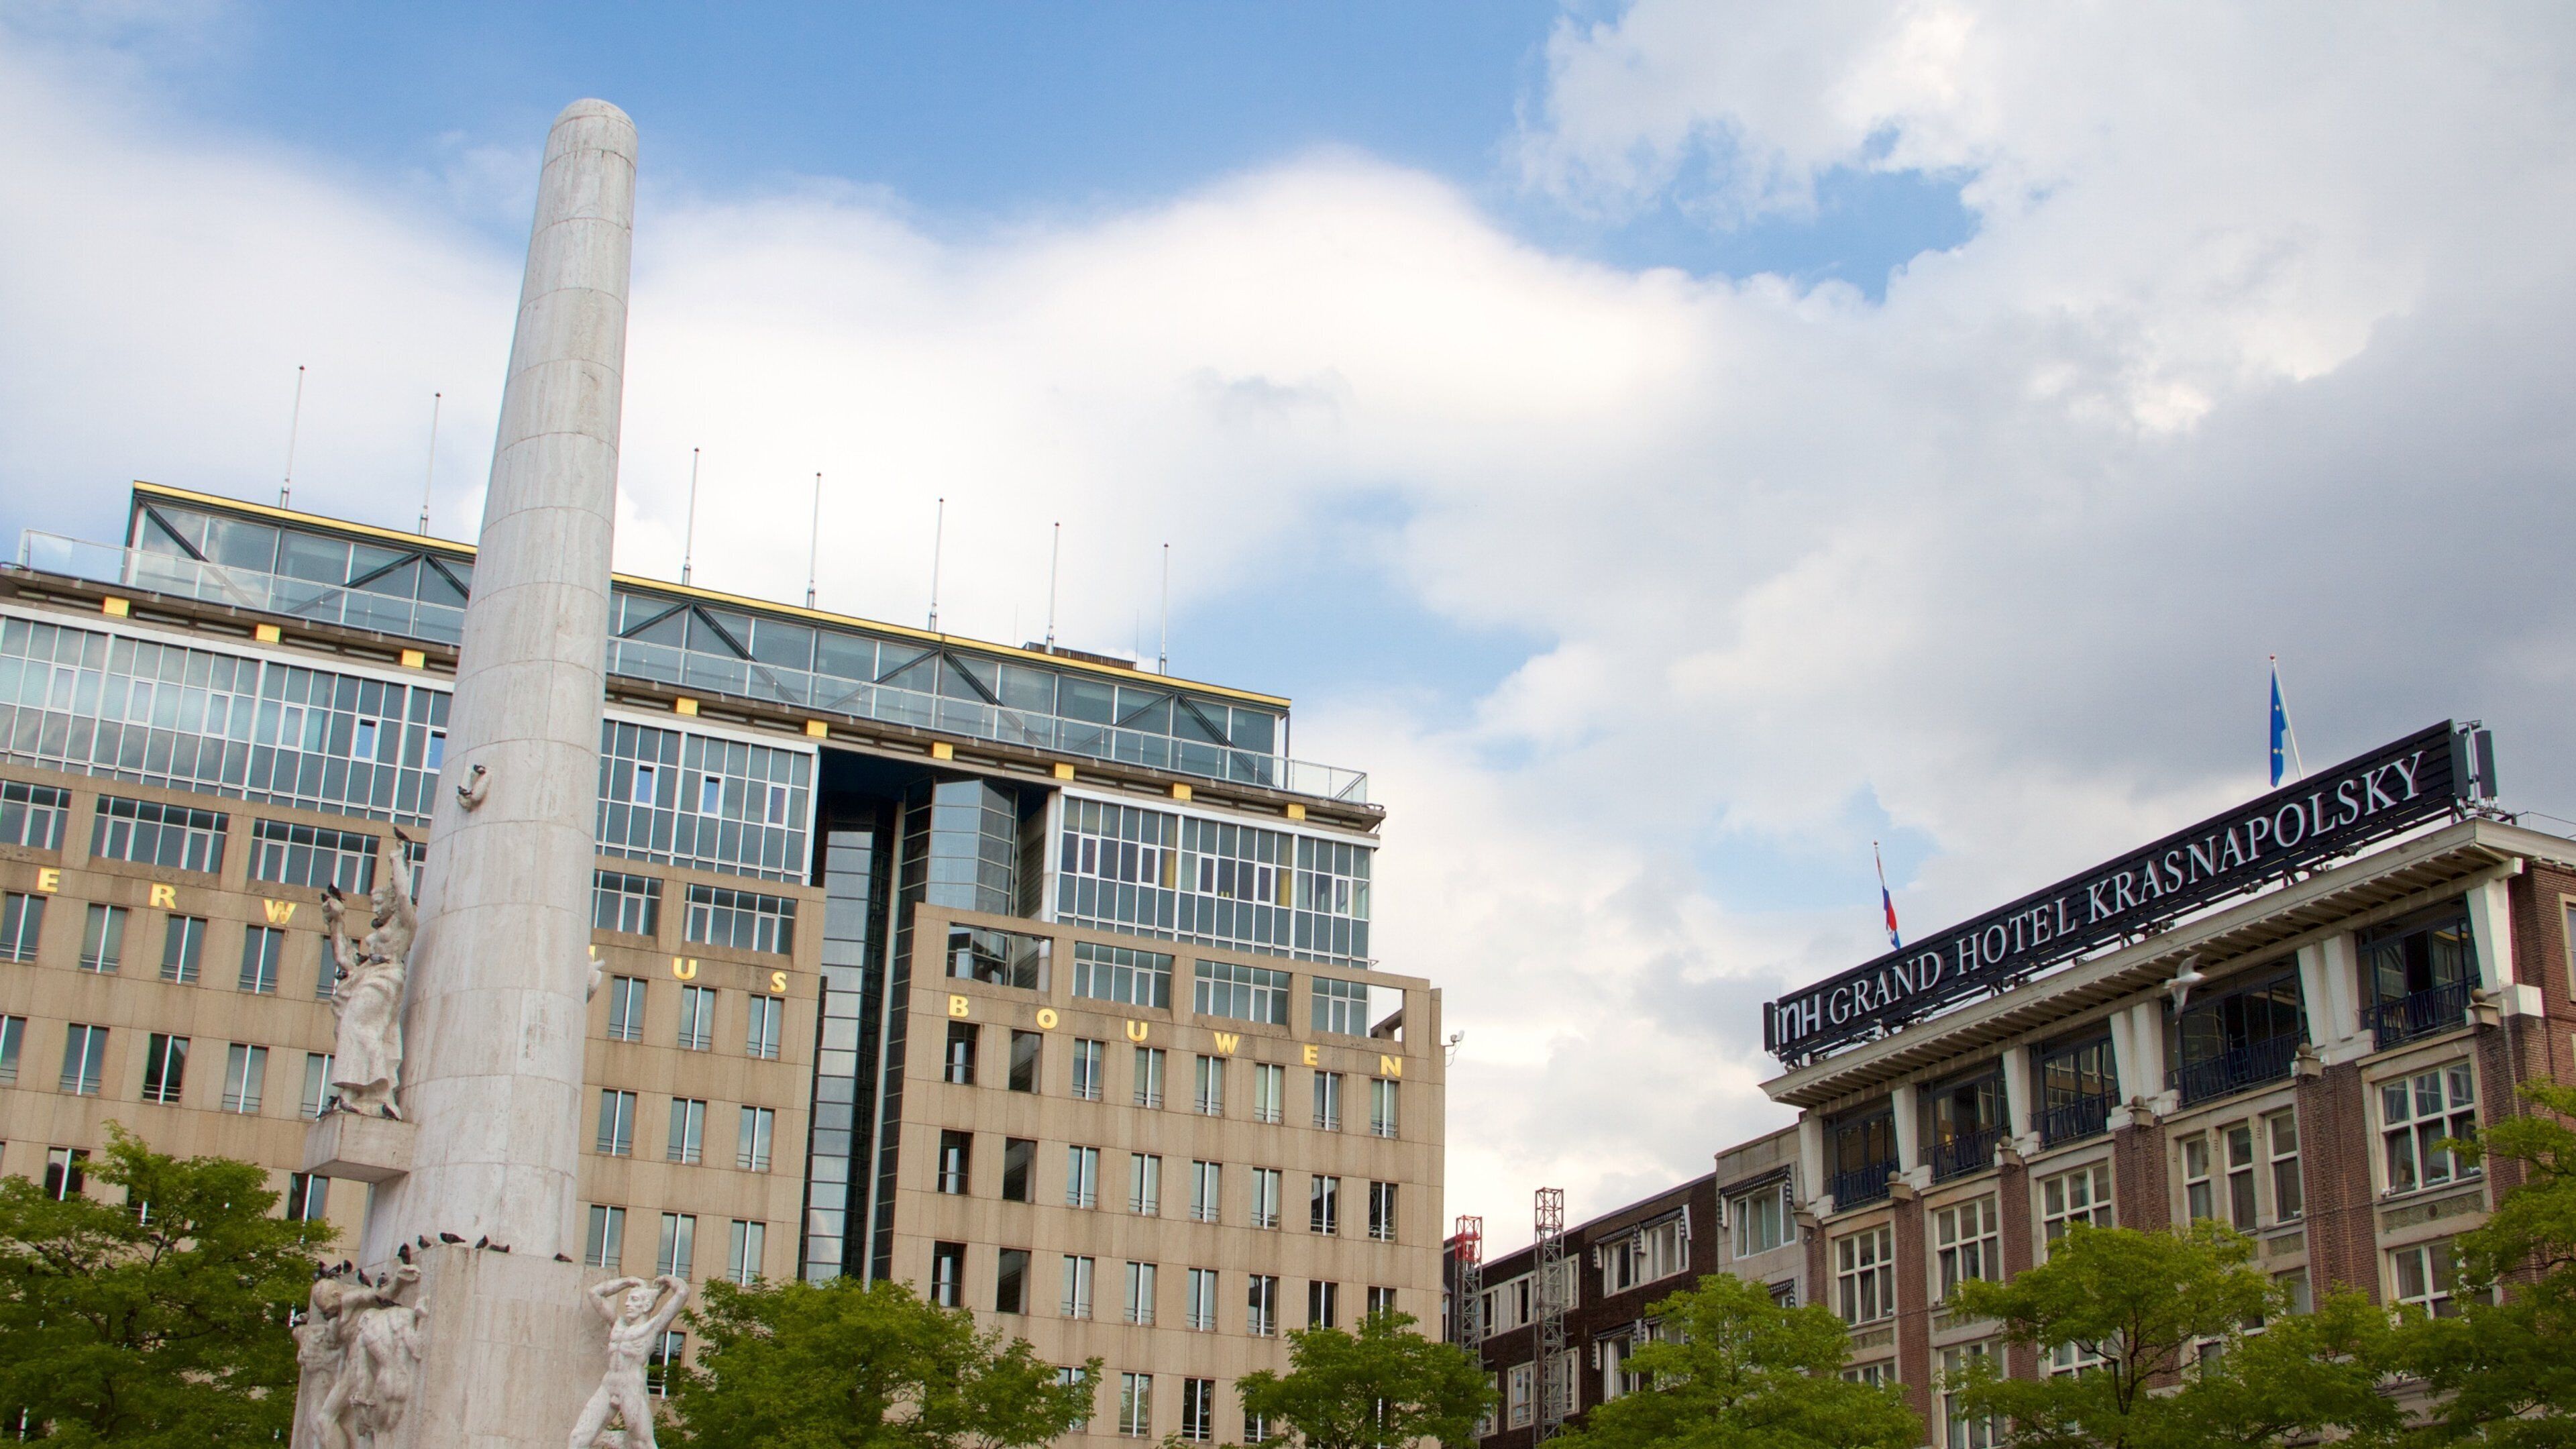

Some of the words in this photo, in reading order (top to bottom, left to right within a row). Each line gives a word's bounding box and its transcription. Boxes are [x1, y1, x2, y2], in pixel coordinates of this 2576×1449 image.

[1829, 951, 1943, 1026] GRAND
[1956, 896, 2077, 975] HOTEL
[2086, 750, 2427, 924] KRASNAPOLSKY
[948, 995, 1403, 1077] BOUWEN
